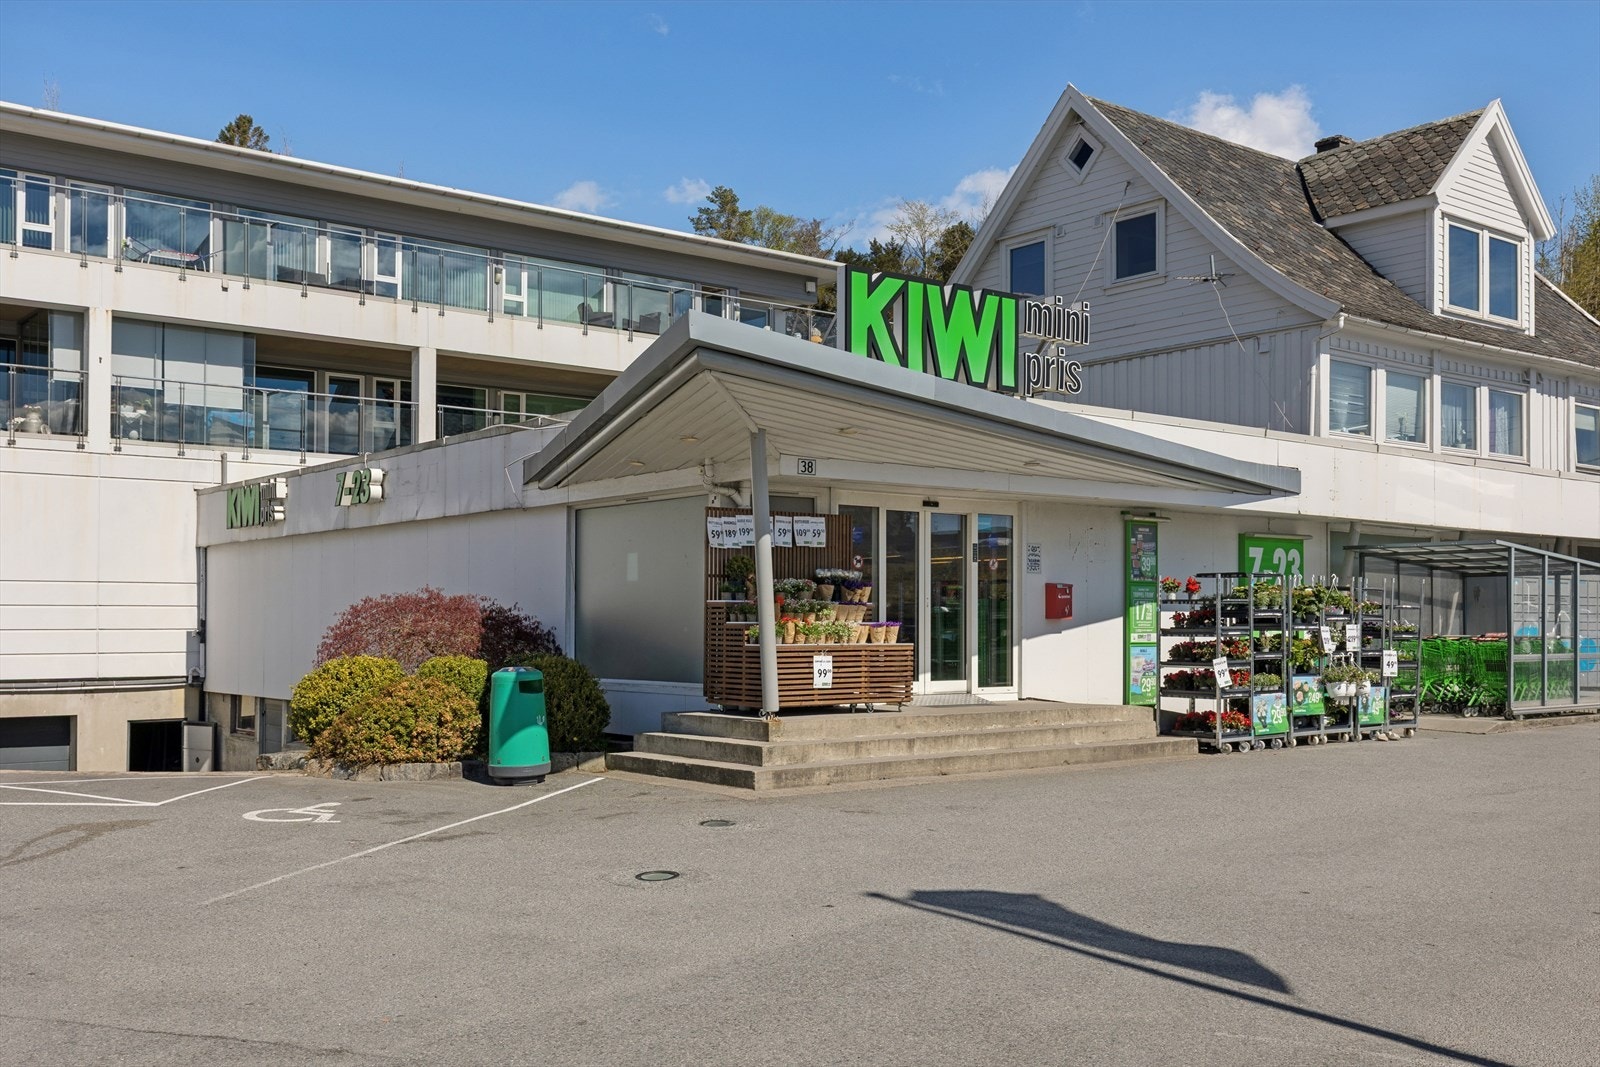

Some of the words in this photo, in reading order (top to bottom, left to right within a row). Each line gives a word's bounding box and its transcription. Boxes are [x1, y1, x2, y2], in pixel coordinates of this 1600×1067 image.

[1025, 295, 1090, 345] mini
[849, 268, 1018, 391] KIWI
[1024, 346, 1082, 397] pris
[800, 460, 814, 474] 38
[335, 468, 371, 507] 7-23
[227, 483, 261, 529] KIWI
[711, 529, 721, 539] 59
[725, 529, 736, 538] 189
[738, 527, 750, 536] 199
[778, 527, 787, 537] 59
[796, 528, 807, 537] 109
[812, 528, 822, 538] 59
[1141, 557, 1151, 571] 39
[817, 668, 828, 678] 99
[1141, 677, 1151, 692] 29
[1272, 709, 1283, 723] 29
